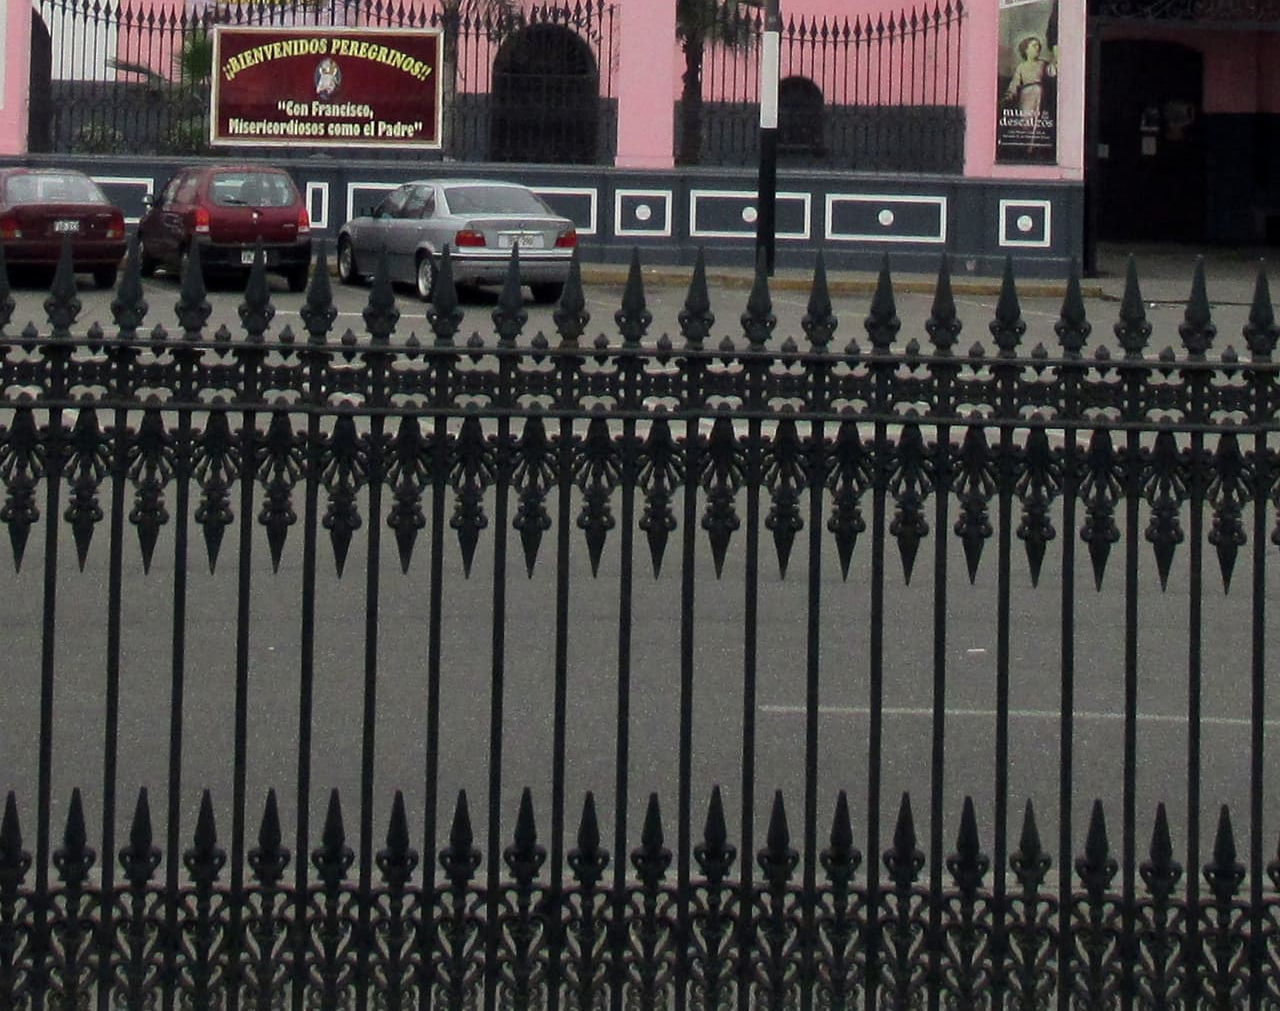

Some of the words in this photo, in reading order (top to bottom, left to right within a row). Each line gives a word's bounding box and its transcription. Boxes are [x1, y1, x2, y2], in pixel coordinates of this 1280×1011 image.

[222, 38, 328, 81] ¡¡BIENVENIDOS
[331, 38, 433, 81] PEREGRINOS!!
[312, 101, 374, 120] Francisco,
[228, 118, 326, 136] Misericordiosos
[327, 122, 361, 136] como
[363, 120, 375, 136] el
